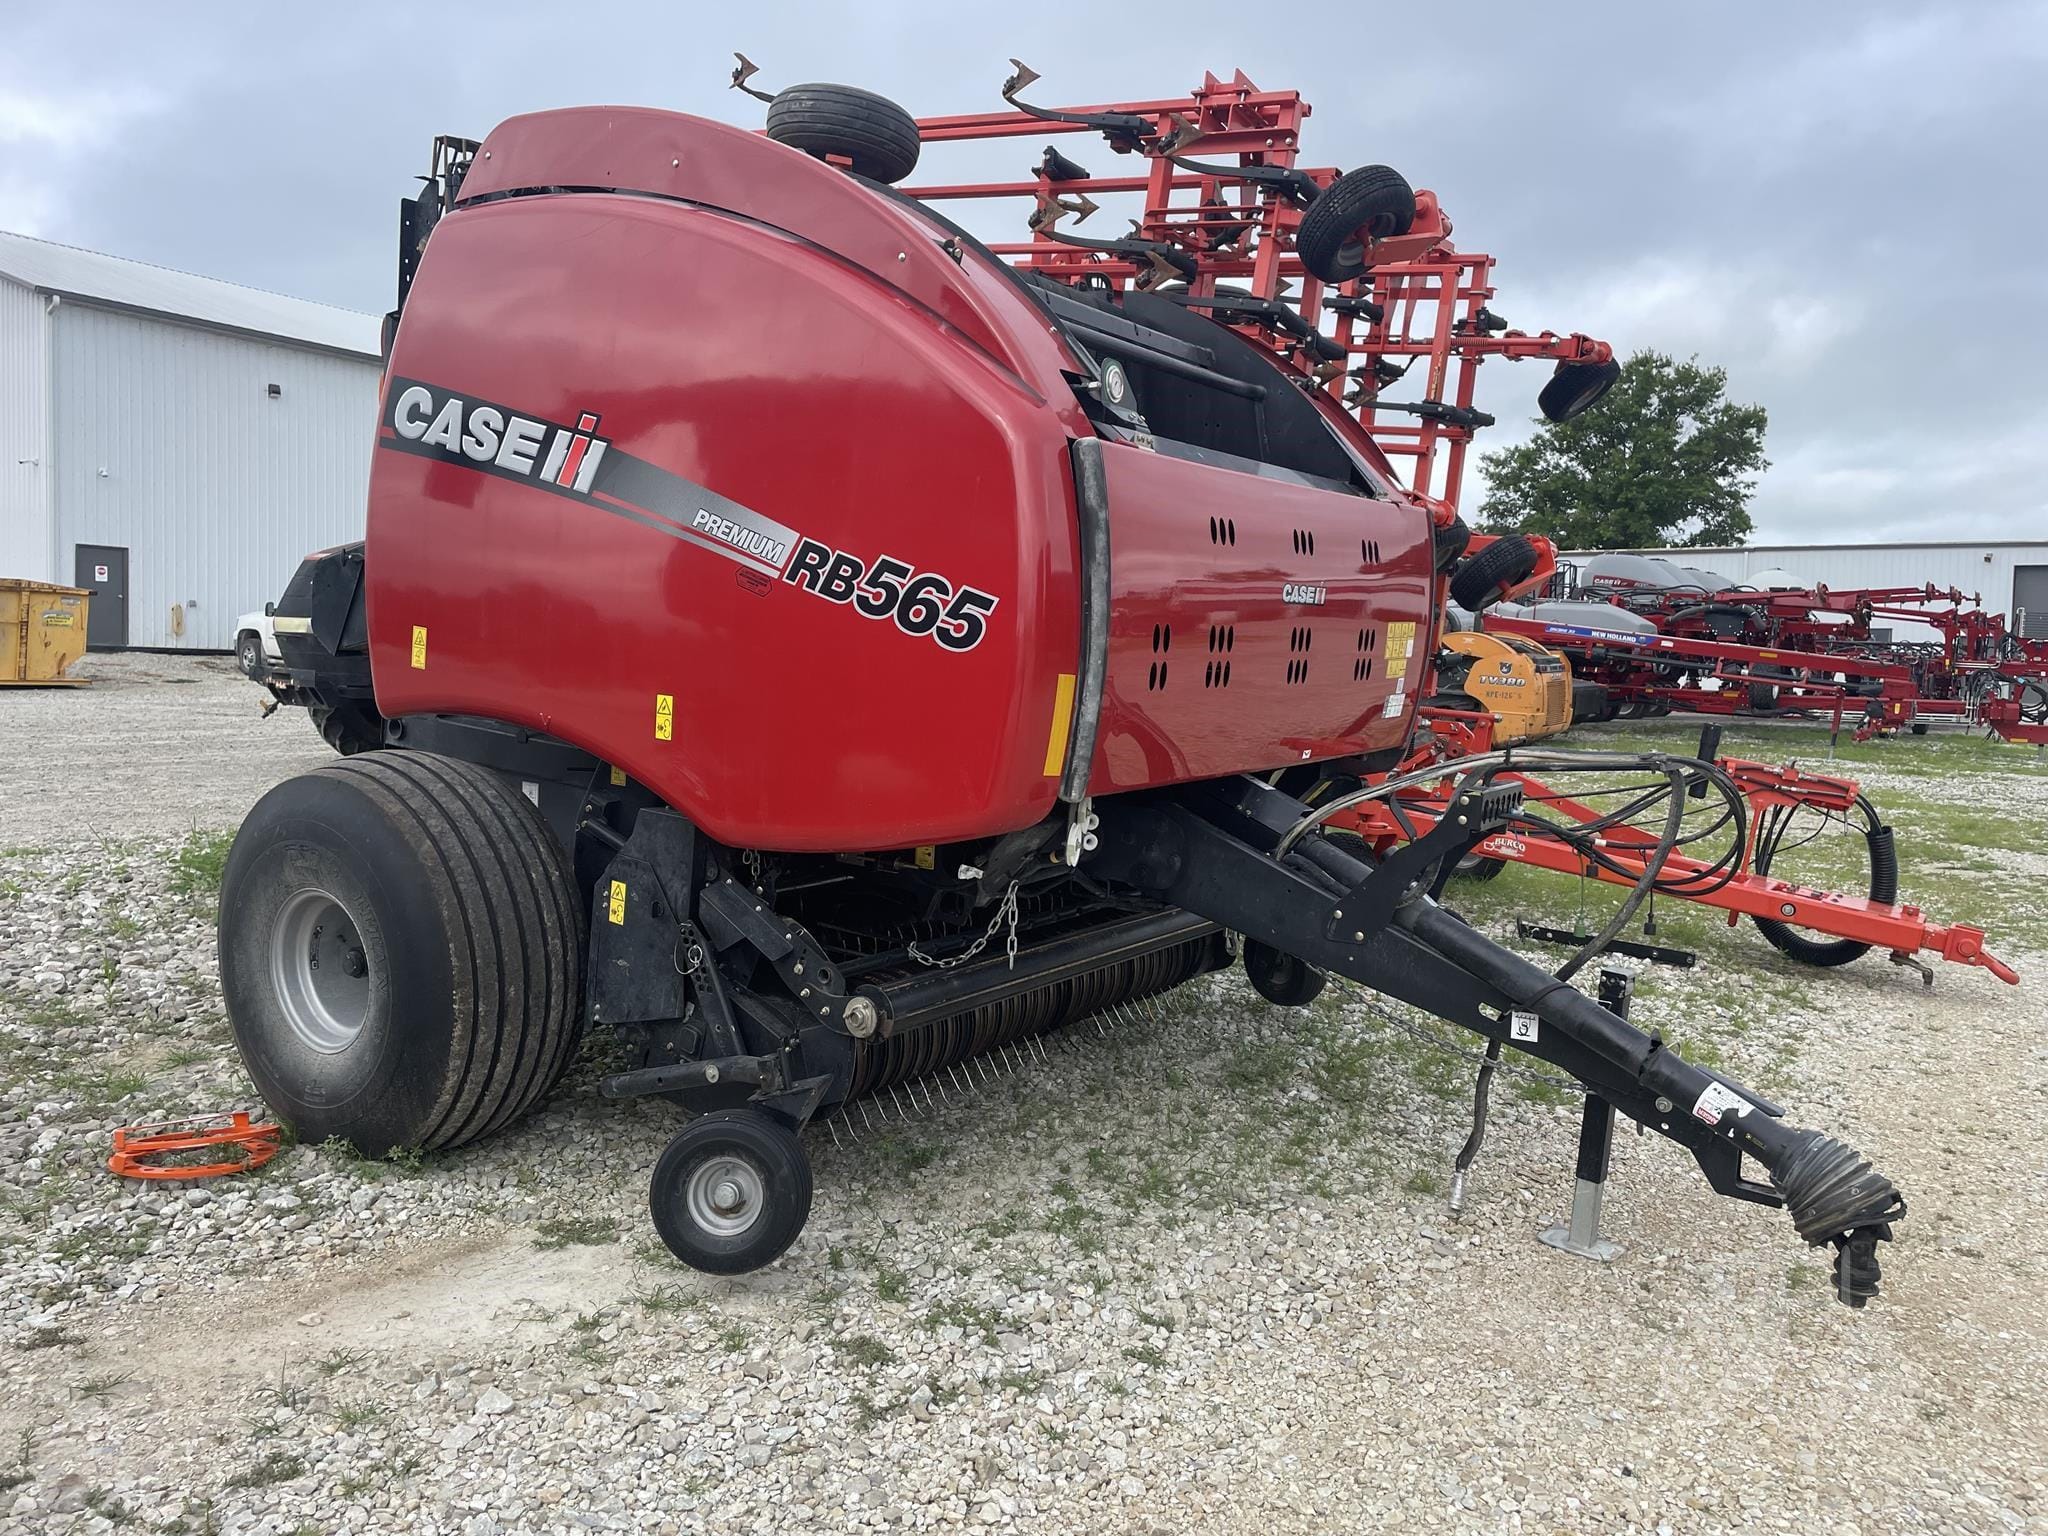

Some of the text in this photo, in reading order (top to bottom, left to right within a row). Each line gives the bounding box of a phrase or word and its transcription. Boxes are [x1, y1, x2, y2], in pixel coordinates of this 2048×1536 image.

[691, 507, 786, 563] PREMIUM
[782, 537, 1000, 653] RB565
[1591, 630, 1637, 643] NEW HOLLAND
[1479, 675, 1527, 688] TV380
